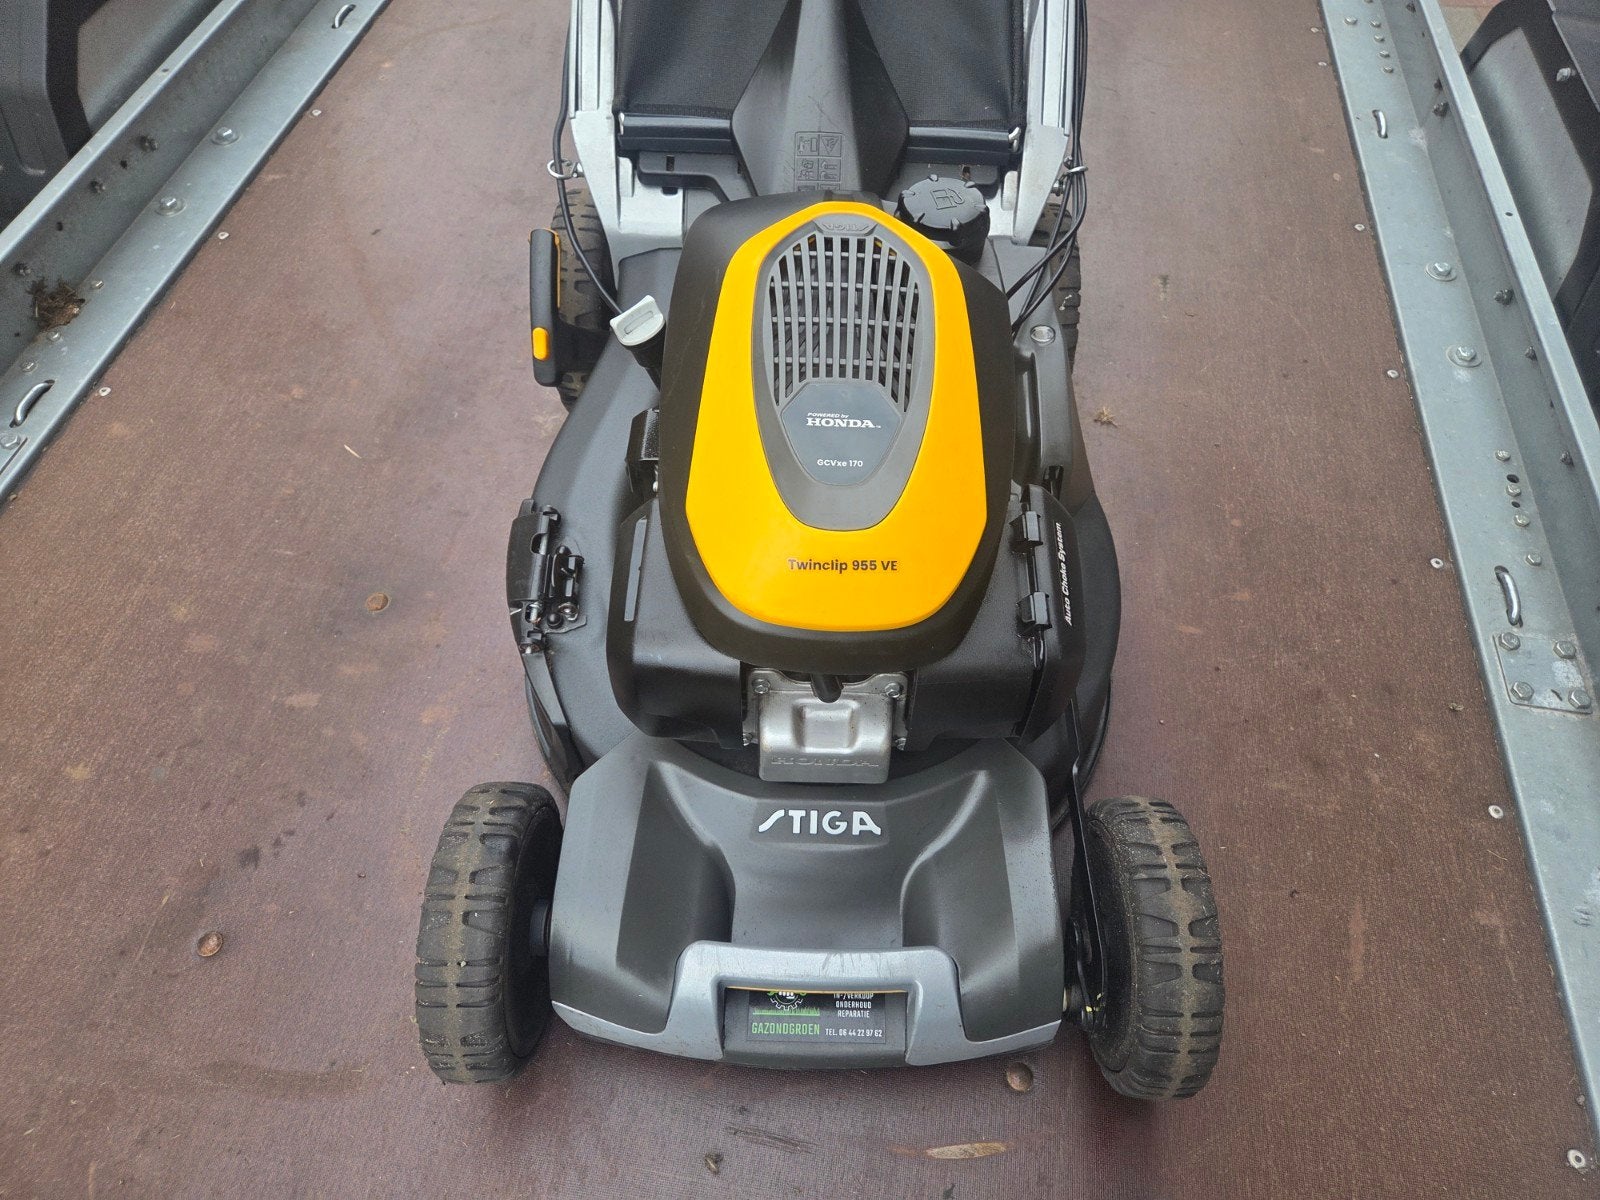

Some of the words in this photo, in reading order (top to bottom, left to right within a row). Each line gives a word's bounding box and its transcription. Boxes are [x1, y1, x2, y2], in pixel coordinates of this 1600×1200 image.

[806, 417, 876, 428] HONDA
[817, 459, 847, 467] GCVxe
[1056, 522, 1066, 562] System
[788, 559, 848, 574] Twinclip
[852, 560, 877, 571] 955
[881, 560, 898, 571] VE
[1060, 562, 1069, 596] Choke
[758, 809, 881, 835] STIGA
[835, 1001, 872, 1009] ONDERHOUD
[837, 1010, 870, 1018] REPARATIE
[857, 1029, 865, 1037] 22
[866, 1029, 874, 1037] 97
